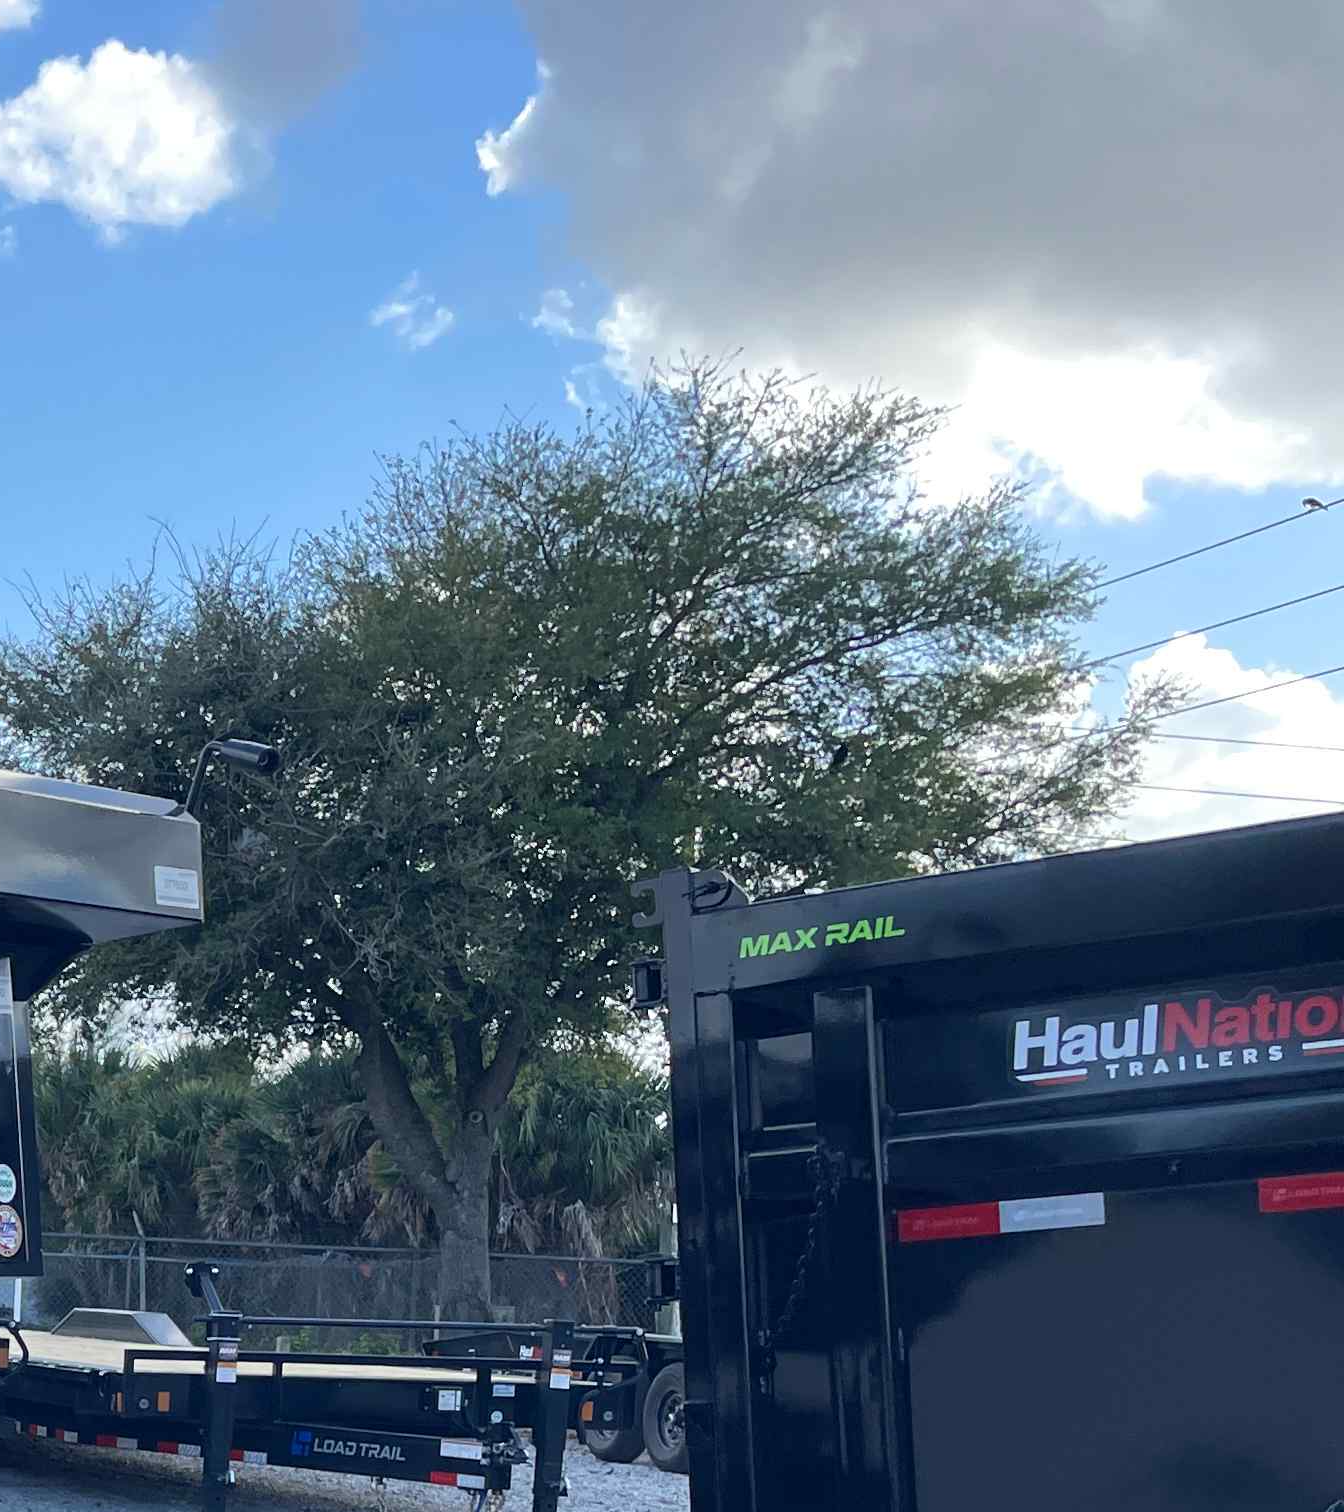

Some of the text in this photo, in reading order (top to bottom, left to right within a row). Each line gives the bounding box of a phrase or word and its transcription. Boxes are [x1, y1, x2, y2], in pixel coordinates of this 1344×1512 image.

[739, 915, 906, 959] MAX RAIL
[1013, 992, 1344, 1070] HaulNatio
[1105, 1044, 1284, 1079] TRAILERS
[313, 1437, 406, 1461] LOAD TRAIL
